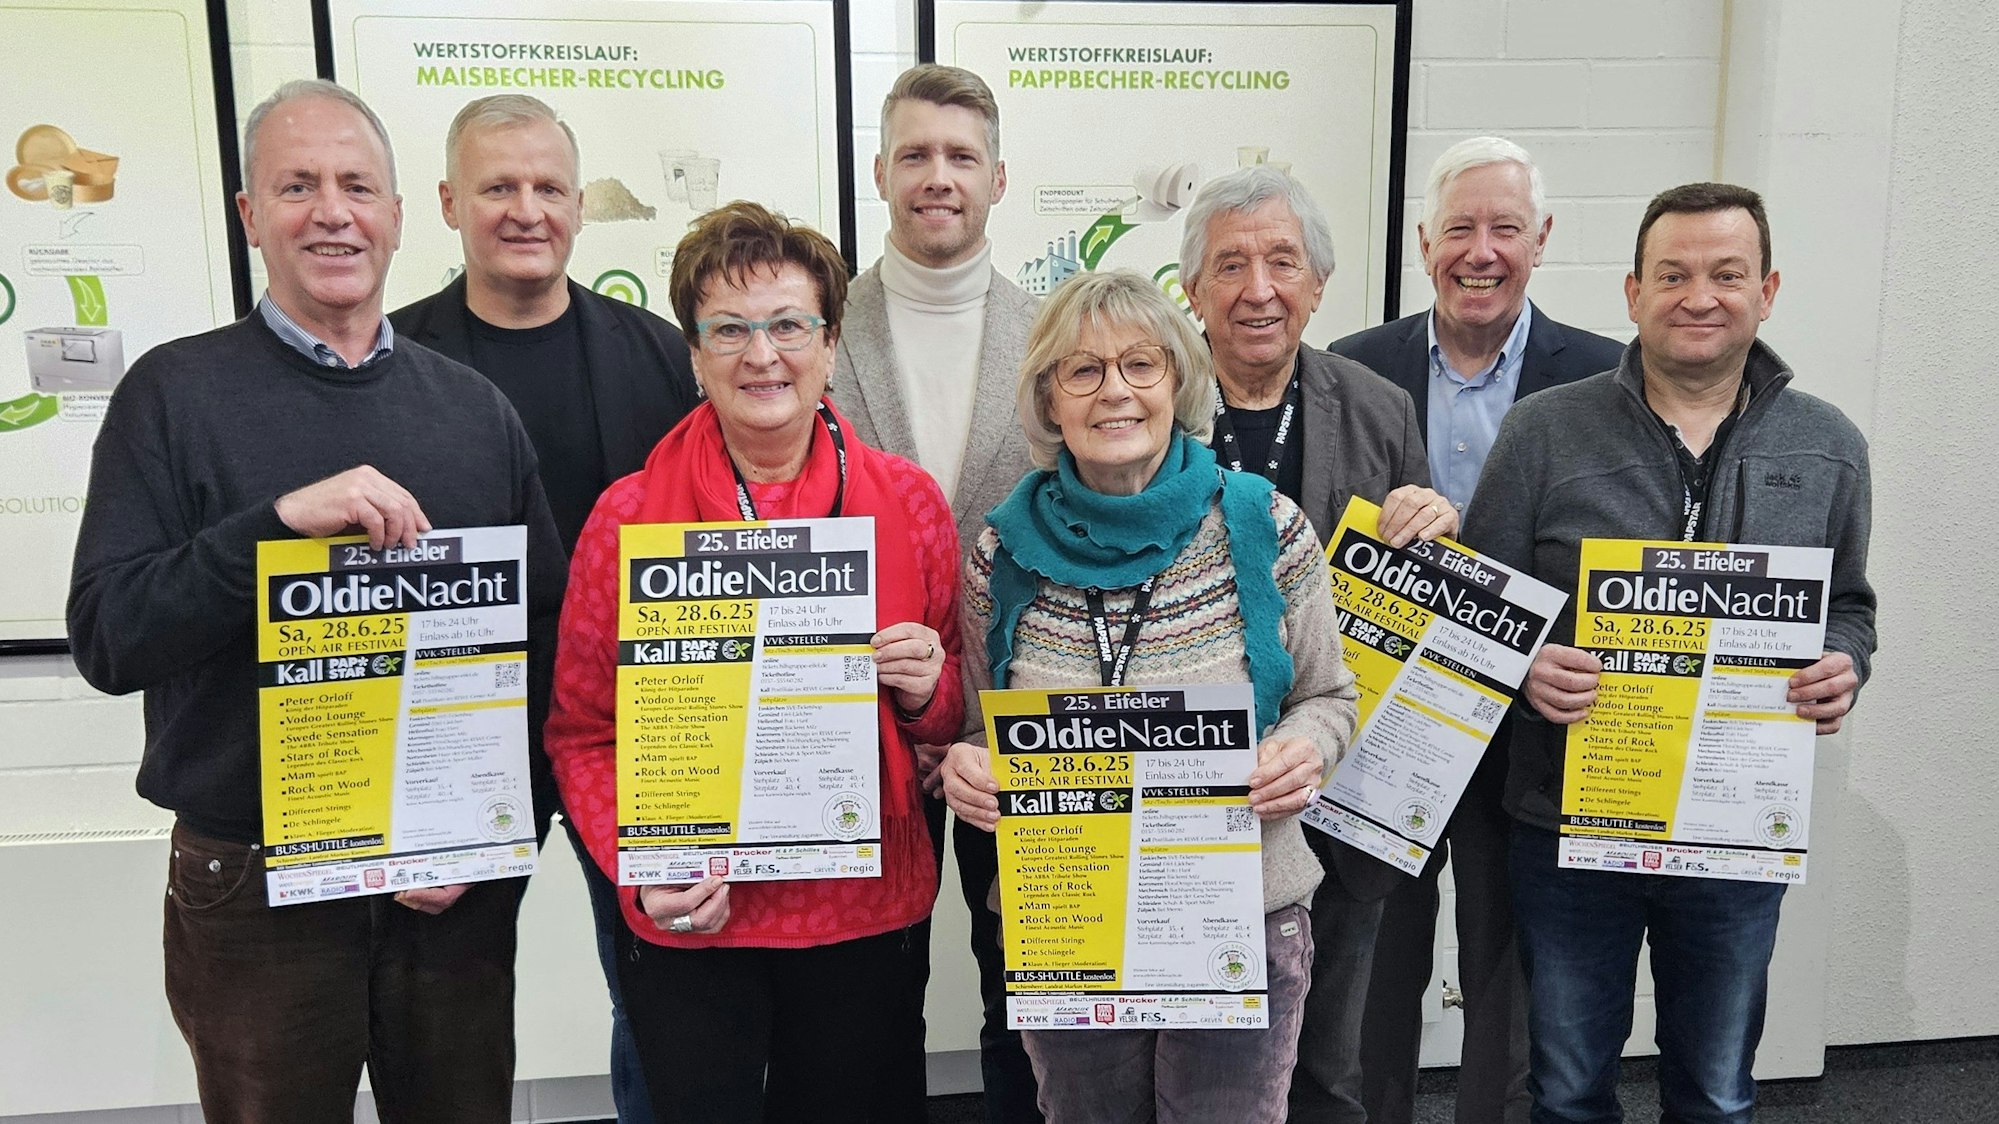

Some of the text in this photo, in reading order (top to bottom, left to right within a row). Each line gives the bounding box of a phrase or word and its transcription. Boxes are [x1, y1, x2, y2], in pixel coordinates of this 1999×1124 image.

[413, 42, 638, 61] WERTSTOFFKREISLAUF:
[1008, 47, 1213, 64] WERTSTOFFKREISLAUF:
[416, 65, 725, 90] MAISBECHER-RECYCLING
[1008, 69, 1290, 90] PAPPBECHER-RECYCLING
[1275, 404, 1294, 444] PAPSTAR
[1683, 502, 1702, 542] APSTAR
[698, 529, 797, 552] 25. Eifeler
[344, 549, 378, 566] 25.
[1656, 551, 1754, 572] 25. Eifeler
[1439, 549, 1496, 586] Eifeler
[640, 557, 856, 598] OldieNacht
[281, 568, 508, 616] OldieNacht
[1331, 572, 1429, 627] Sa, 28.6.25
[1344, 542, 1528, 653] OldieNacht
[1598, 576, 1808, 625] OldieNacht
[638, 603, 753, 625] Sa, 28.6.25
[1332, 592, 1419, 639] PEN AIR FESTIVAL
[279, 618, 404, 644] Sa, 28.6.25
[636, 624, 754, 636] OPEN AIR FESTIVAL
[1594, 616, 1705, 637] Sa, 28.6.25
[763, 635, 829, 647] VVK-STELLEN
[1094, 616, 1112, 662] PAPSTAR
[1348, 625, 1379, 646] STAR
[1592, 636, 1704, 650] OPEN AIR FESTIVAL
[278, 638, 404, 656] OPEN AIR FESTIVAL
[414, 646, 481, 660] VVK-STELLEN
[634, 640, 676, 663] Kall
[681, 650, 716, 661] STAR
[1712, 654, 1777, 670] VVK-STELLEN
[278, 659, 324, 684] Kall
[1111, 645, 1130, 687] APSTAR
[1419, 646, 1477, 682] VVK-STELLEN
[1633, 661, 1666, 673] STAR
[329, 666, 365, 679] STAR
[641, 674, 704, 686] Peter Orloff
[286, 692, 353, 706] Peter Orloff
[641, 695, 716, 706] Vodoo Lounge
[1063, 693, 1170, 710] 25. Eifeler
[1591, 698, 1664, 714] Vodoo Lounge
[640, 712, 728, 724] Swede Sensation
[286, 728, 378, 742] Swede Sensation
[640, 732, 710, 742] Stars of Rock
[1008, 714, 1236, 752] OldieNacht
[1589, 734, 1655, 747] Stars of Rock
[642, 754, 667, 762] Mam
[1010, 756, 1129, 776] Sa, 28.6.25
[1146, 758, 1205, 767] 17 bis 24 Uhr
[642, 766, 666, 776] Rock
[688, 765, 720, 775] Wood
[1145, 770, 1224, 780] Einlass ab 16 Uhr
[288, 784, 315, 794] Rock
[337, 778, 370, 789] Wood
[1010, 775, 1130, 787] OPEN AIR FESTIVAL
[1142, 787, 1210, 798] VVK-STELLEN
[1010, 791, 1053, 814] Kall
[1058, 801, 1094, 812] STAR
[1570, 816, 1633, 828] BUS-SHUTTLE
[628, 825, 696, 836] BUS-SHUTTLE
[1020, 825, 1083, 836] Peter Orloff
[275, 839, 348, 855] BUS-SHUTTLE
[1021, 845, 1096, 855] Vodoo Lounge
[1022, 862, 1109, 873] Swede Sensation
[1023, 881, 1092, 891] Stars of Rock
[1025, 902, 1050, 910] Mam
[1026, 914, 1050, 924] Rock
[1072, 913, 1103, 922] Wood
[1015, 971, 1081, 981] BUS-SHUTTLE
